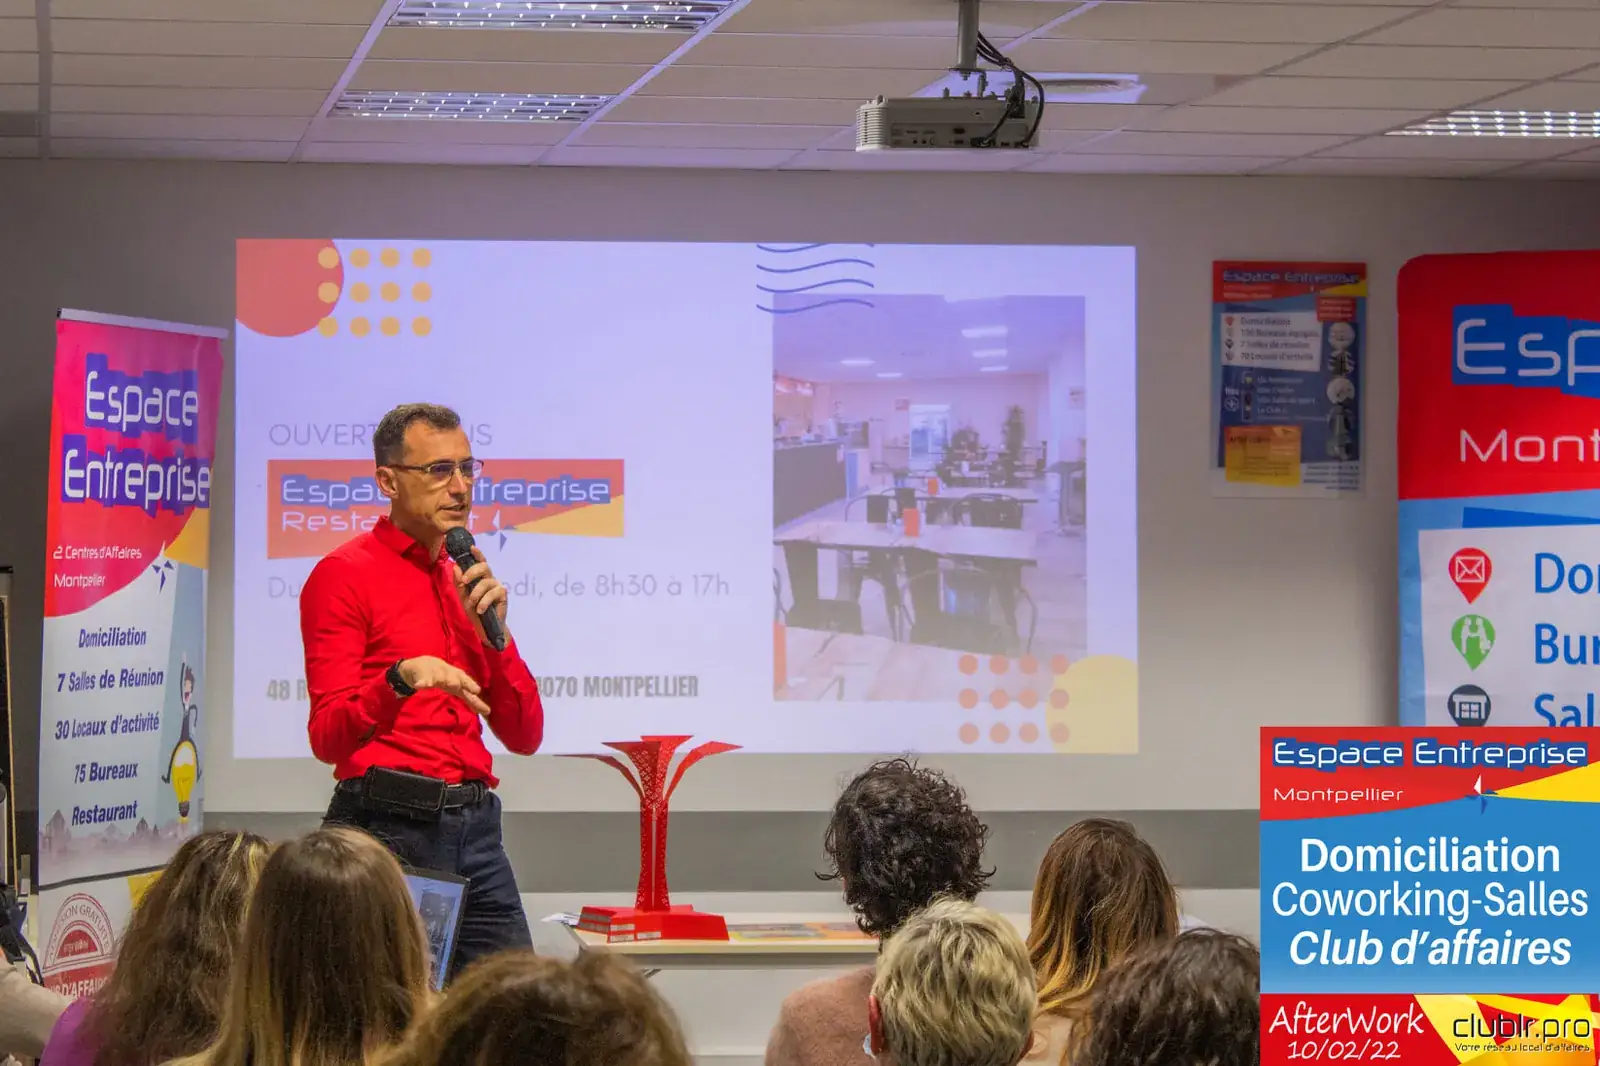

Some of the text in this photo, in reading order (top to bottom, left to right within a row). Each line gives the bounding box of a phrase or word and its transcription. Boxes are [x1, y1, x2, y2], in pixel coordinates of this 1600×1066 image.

[1223, 271, 1280, 283] Espace
[86, 370, 199, 432] Espace
[63, 448, 211, 510] Entreprise
[282, 478, 609, 507] Espac treprise
[53, 545, 142, 560] 2 Centres d'Affaires
[553, 573, 586, 597] de
[594, 573, 657, 597] 8h30
[666, 575, 682, 597] à
[691, 572, 730, 597] 17h
[1534, 552, 1600, 595] Do
[78, 626, 148, 649] Domiciliation
[56, 666, 164, 693] 7 Salles de Réunion
[266, 679, 290, 701] 48
[536, 675, 578, 698] 070
[583, 675, 699, 698] MONTPELLIER
[55, 710, 160, 740] 30 Locaux d'activité
[74, 761, 139, 784] 75 Bureaux
[72, 800, 138, 827] Restaurant
